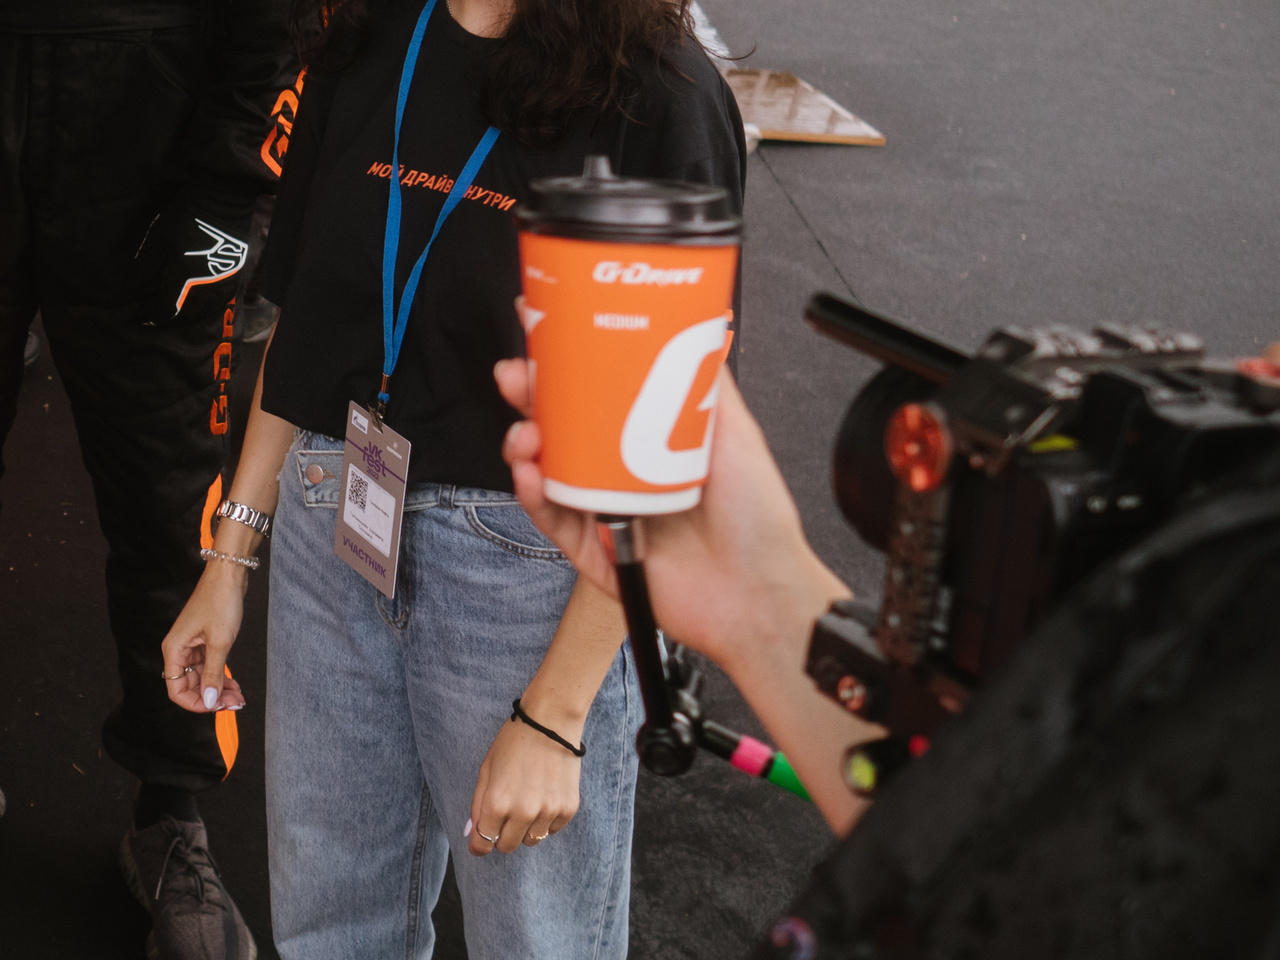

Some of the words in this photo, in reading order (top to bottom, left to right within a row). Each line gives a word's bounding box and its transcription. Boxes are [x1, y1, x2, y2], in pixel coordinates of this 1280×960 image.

[401, 170, 455, 194] ДРАЙВ
[463, 185, 517, 211] НУТРИ
[593, 313, 650, 331] MEDIUM
[343, 535, 387, 578] УЧАСТНИК
